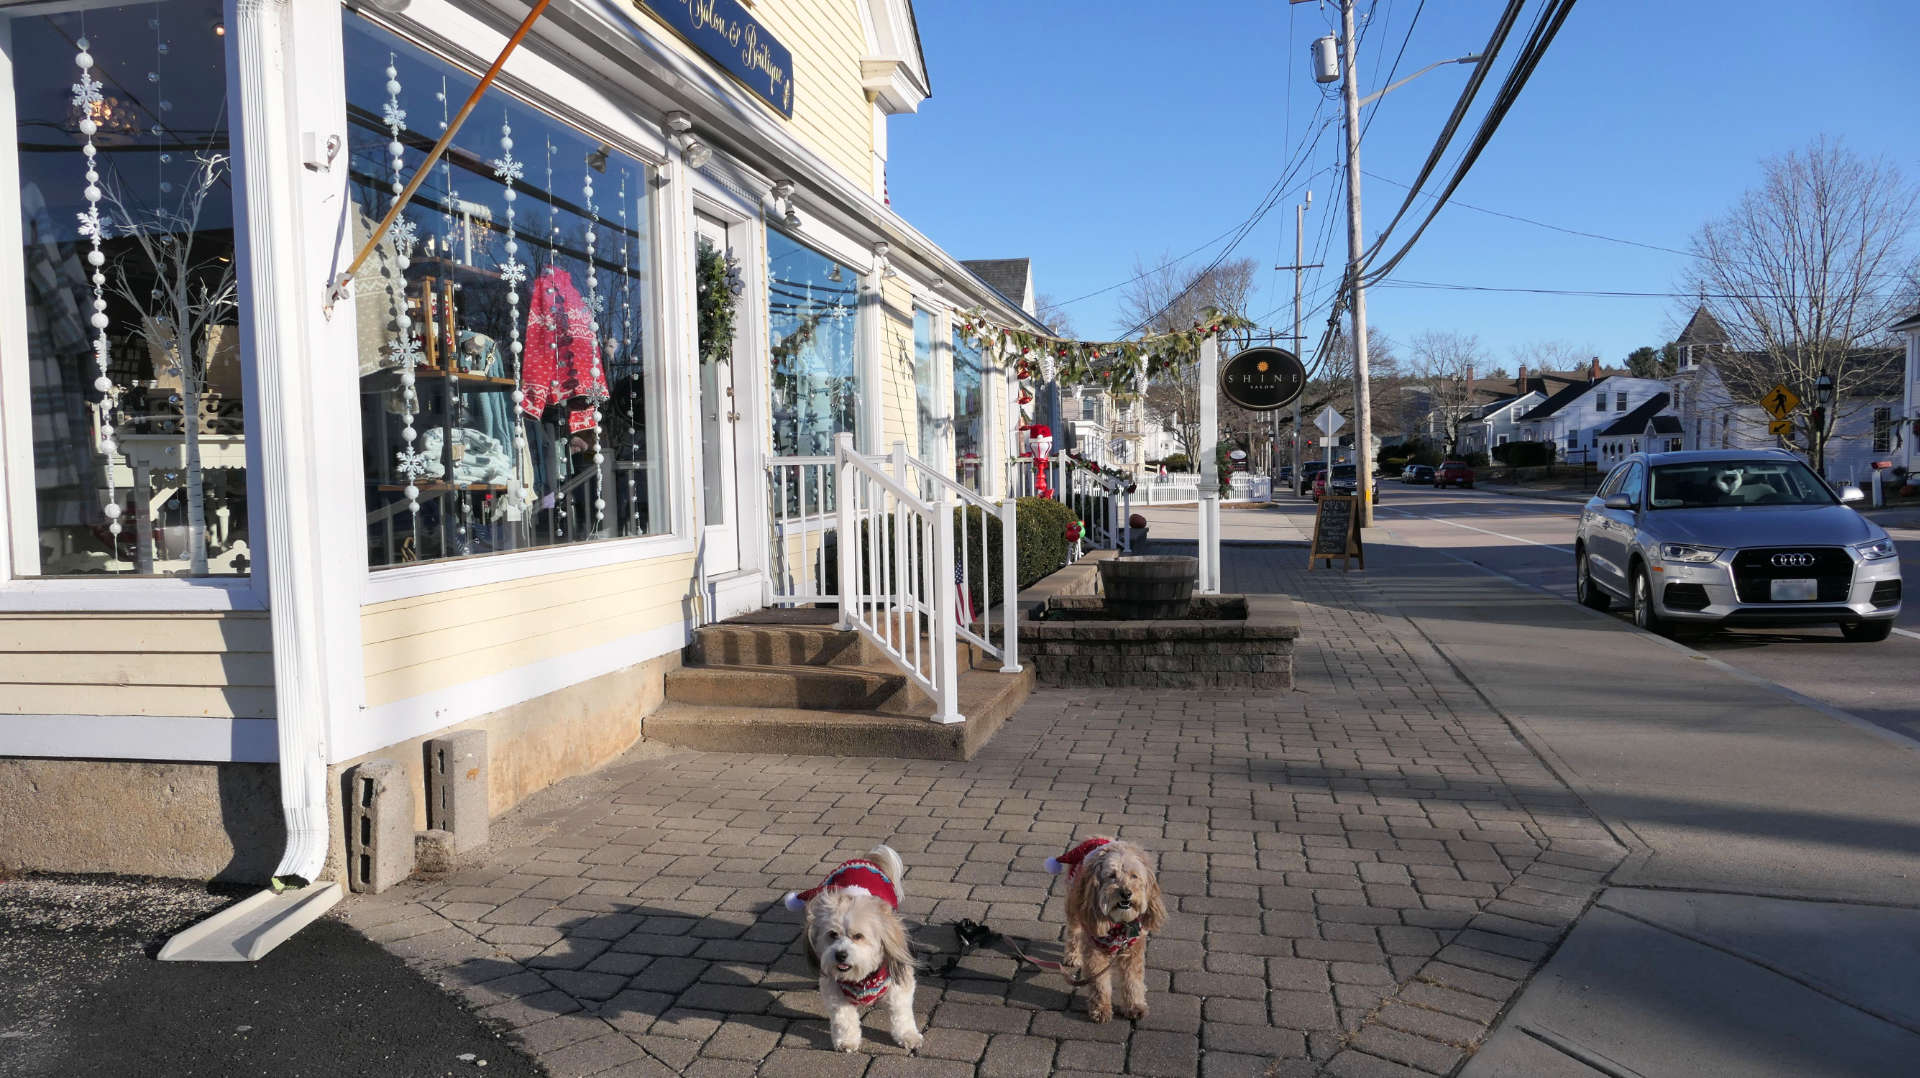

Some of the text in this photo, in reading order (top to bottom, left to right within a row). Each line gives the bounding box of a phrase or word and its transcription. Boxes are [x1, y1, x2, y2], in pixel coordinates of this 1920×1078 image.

[689, 0, 782, 96] Salon & Boutique
[1228, 374, 1298, 383] SHINE
